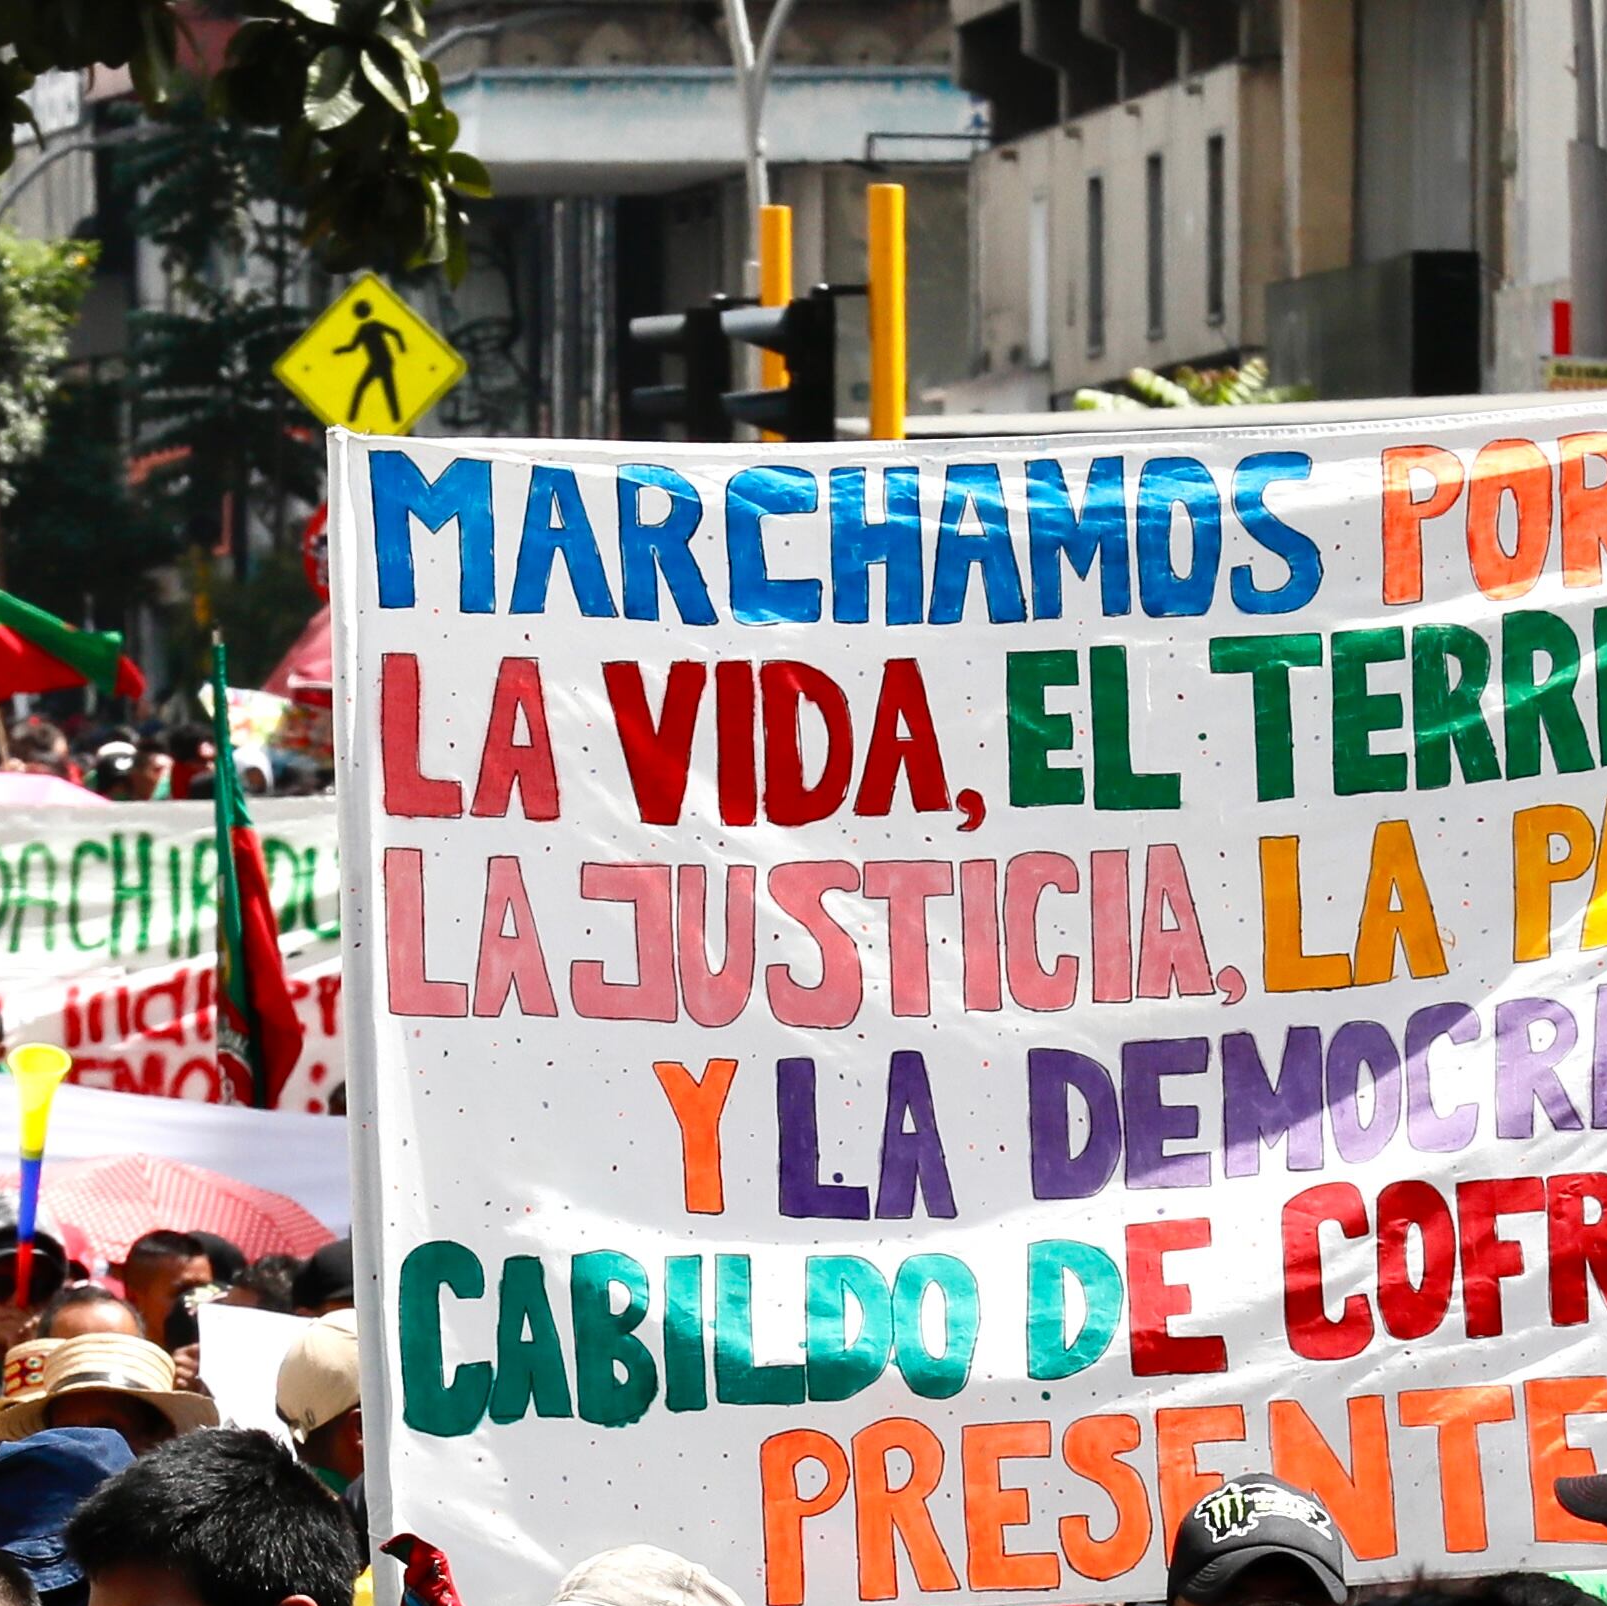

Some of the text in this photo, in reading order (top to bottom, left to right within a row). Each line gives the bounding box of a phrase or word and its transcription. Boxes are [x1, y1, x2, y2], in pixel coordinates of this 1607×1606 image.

[370, 450, 1322, 626] MARCHAMOS
[380, 652, 561, 821] LA
[602, 658, 986, 832] VIDA,
[1006, 644, 1182, 811] EL
[385, 848, 556, 1019] LA
[571, 842, 1243, 1029] JUSTICIA,
[1258, 819, 1449, 993] LA
[653, 1058, 738, 1215] Y
[776, 1051, 957, 1220] LA
[399, 1240, 980, 1437] CABILDO
[1027, 1218, 1228, 1379] DE
